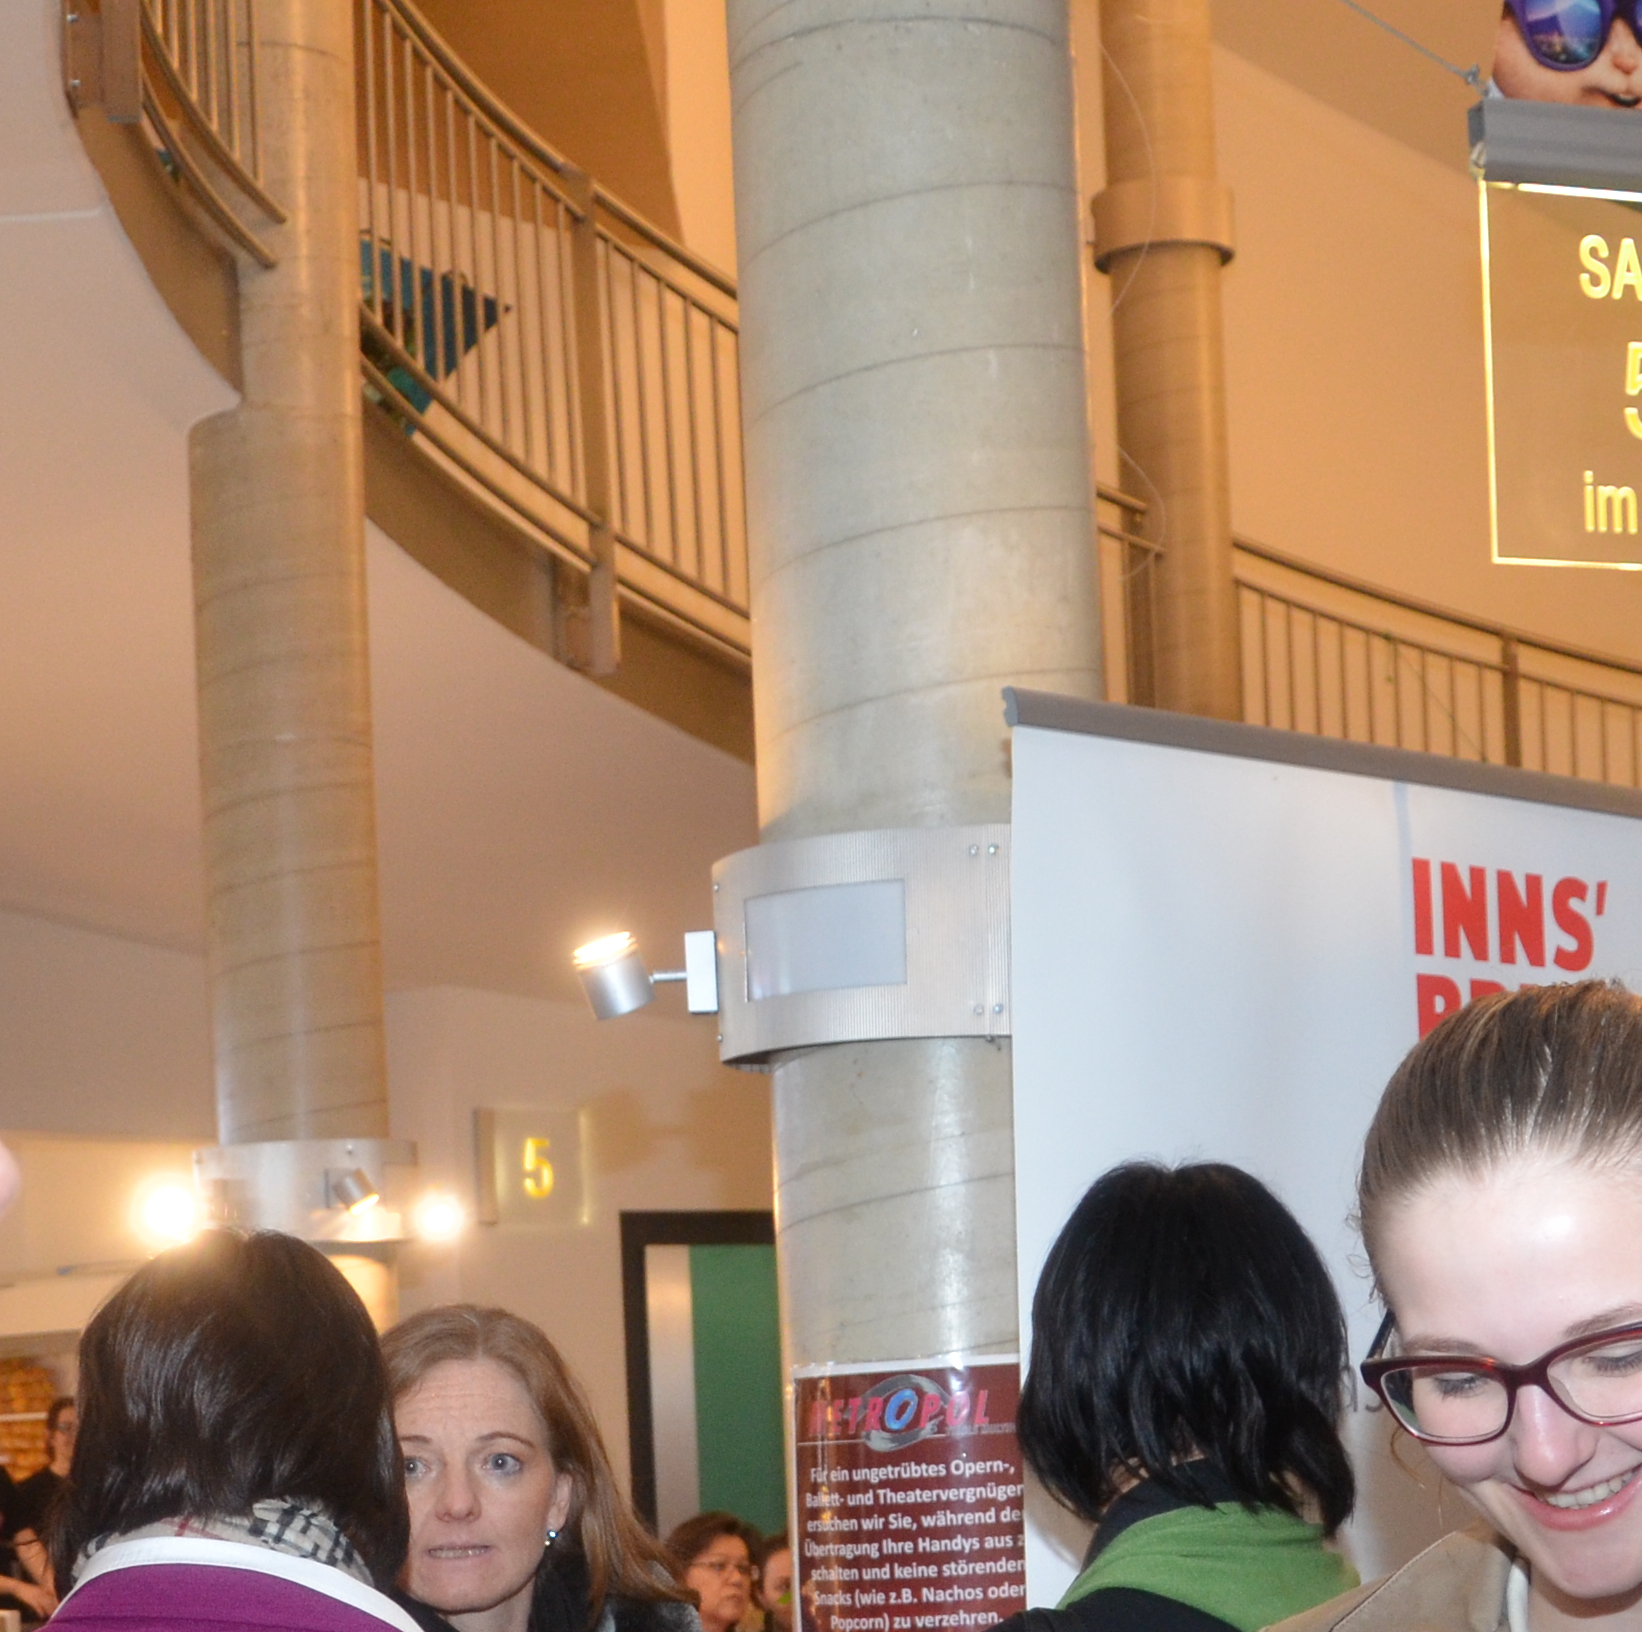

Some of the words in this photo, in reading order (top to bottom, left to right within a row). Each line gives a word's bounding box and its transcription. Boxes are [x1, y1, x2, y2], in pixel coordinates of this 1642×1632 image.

[1582, 469, 1638, 534] im
[1412, 857, 1609, 972] INNS'
[523, 1137, 554, 1198] 5
[830, 1466, 849, 1482] ein
[852, 1462, 946, 1484] ungetrübtes
[951, 1459, 1015, 1480] Opern-,
[847, 1490, 874, 1506] und
[861, 1514, 885, 1530] wir
[888, 1512, 917, 1532] Sie,
[921, 1507, 995, 1529] während
[882, 1538, 914, 1555] Ihre
[918, 1534, 980, 1555] Handys
[984, 1536, 1014, 1549] aus
[811, 1566, 858, 1582] schalten
[862, 1563, 890, 1579] und
[894, 1562, 938, 1579] keine
[855, 1589, 885, 1609] (wie
[889, 1588, 918, 1605] z.B.
[922, 1584, 984, 1602] Nachos
[831, 1613, 890, 1632] Popcorn)
[893, 1615, 911, 1629] zu
[915, 1609, 1004, 1628] verzehren.
